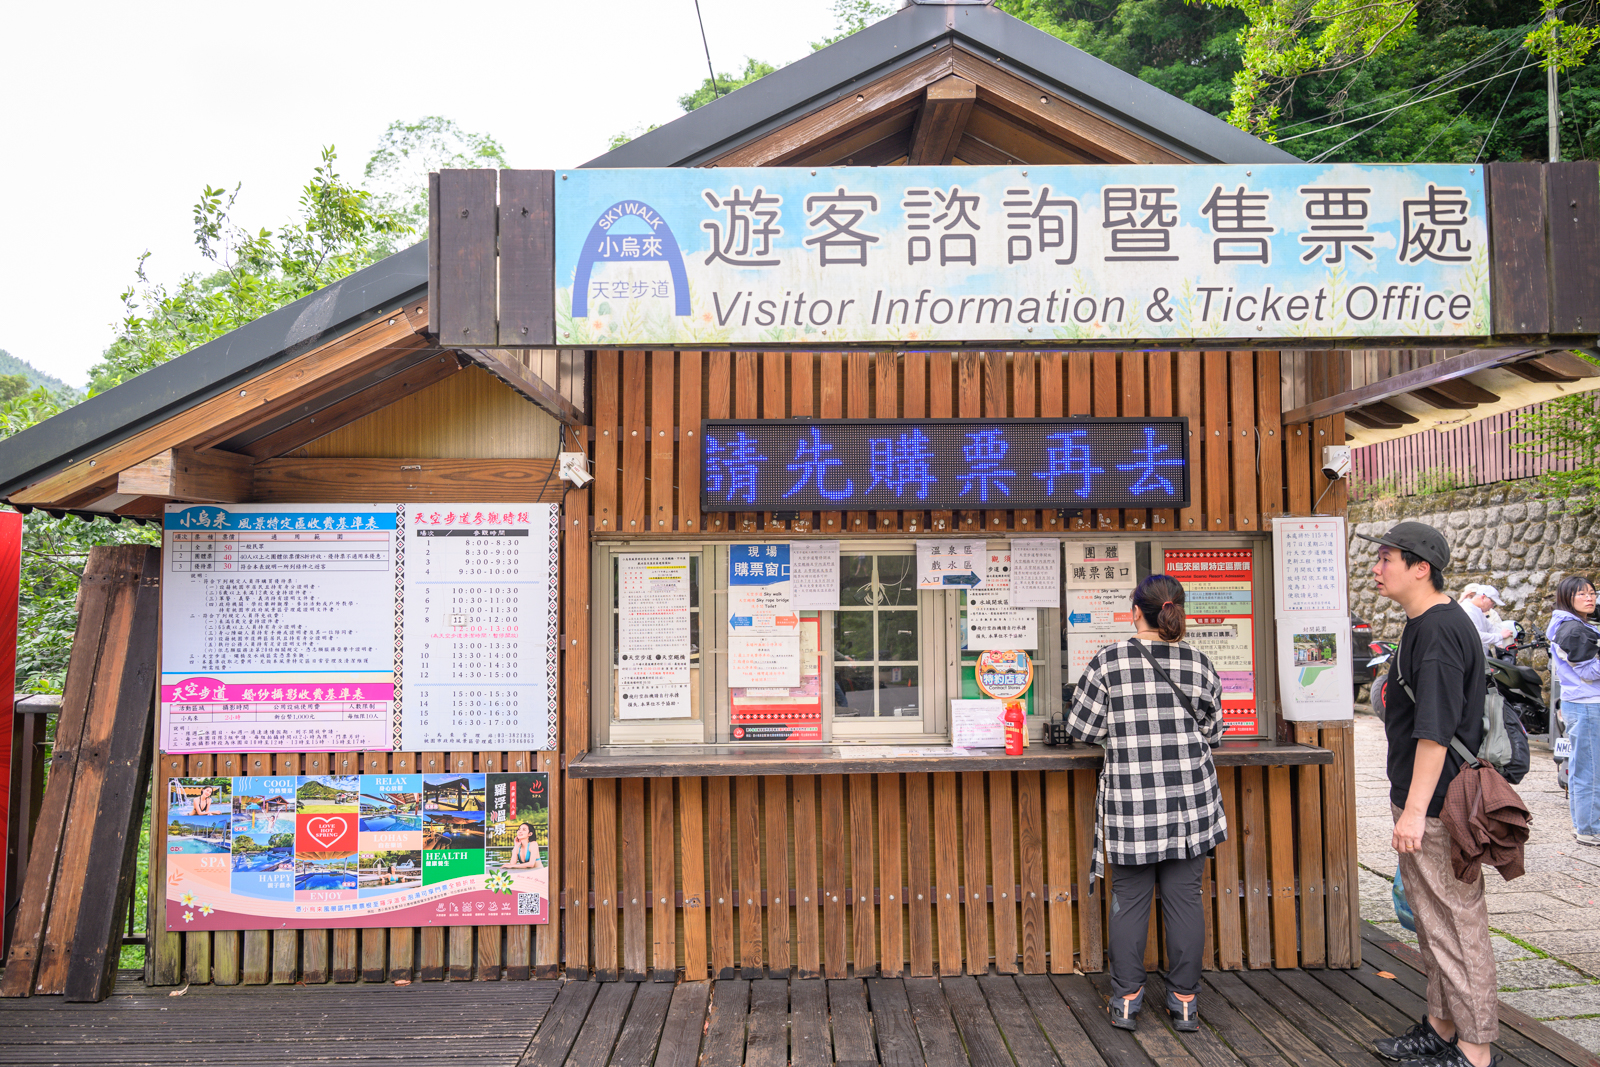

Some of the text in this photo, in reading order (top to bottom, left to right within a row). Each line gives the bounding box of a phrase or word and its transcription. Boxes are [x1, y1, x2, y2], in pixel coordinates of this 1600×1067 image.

[598, 203, 663, 230] SKYWALK
[703, 185, 1472, 267] 遊客諮詢暨售票處
[598, 236, 663, 257] 小烏來
[592, 280, 669, 299] 天空步道
[712, 285, 1472, 327] Visitor Information & Ticket Office
[706, 427, 1185, 504] 請先購票再去
[237, 516, 380, 530] 風景特定區收費基準表
[414, 511, 531, 525] 天空步道參觀時段
[748, 546, 777, 557] 現場
[931, 545, 973, 555] 溫泉區
[1085, 546, 1118, 559] 團體
[734, 562, 790, 577] 購票窗口
[931, 561, 973, 571] 戲水區
[1073, 565, 1129, 579] 購票窗口
[1167, 562, 1251, 571] 小烏來風景特定區票價
[921, 576, 940, 584] 入口
[982, 673, 1026, 686] 特約店家
[263, 779, 293, 788] COOL
[375, 777, 407, 786] RELAX
[373, 833, 408, 842] LOHAS
[200, 857, 226, 868] SPA
[425, 852, 468, 861] HEALTH
[259, 874, 292, 882] HAPPY
[310, 892, 343, 901] ENJOY
